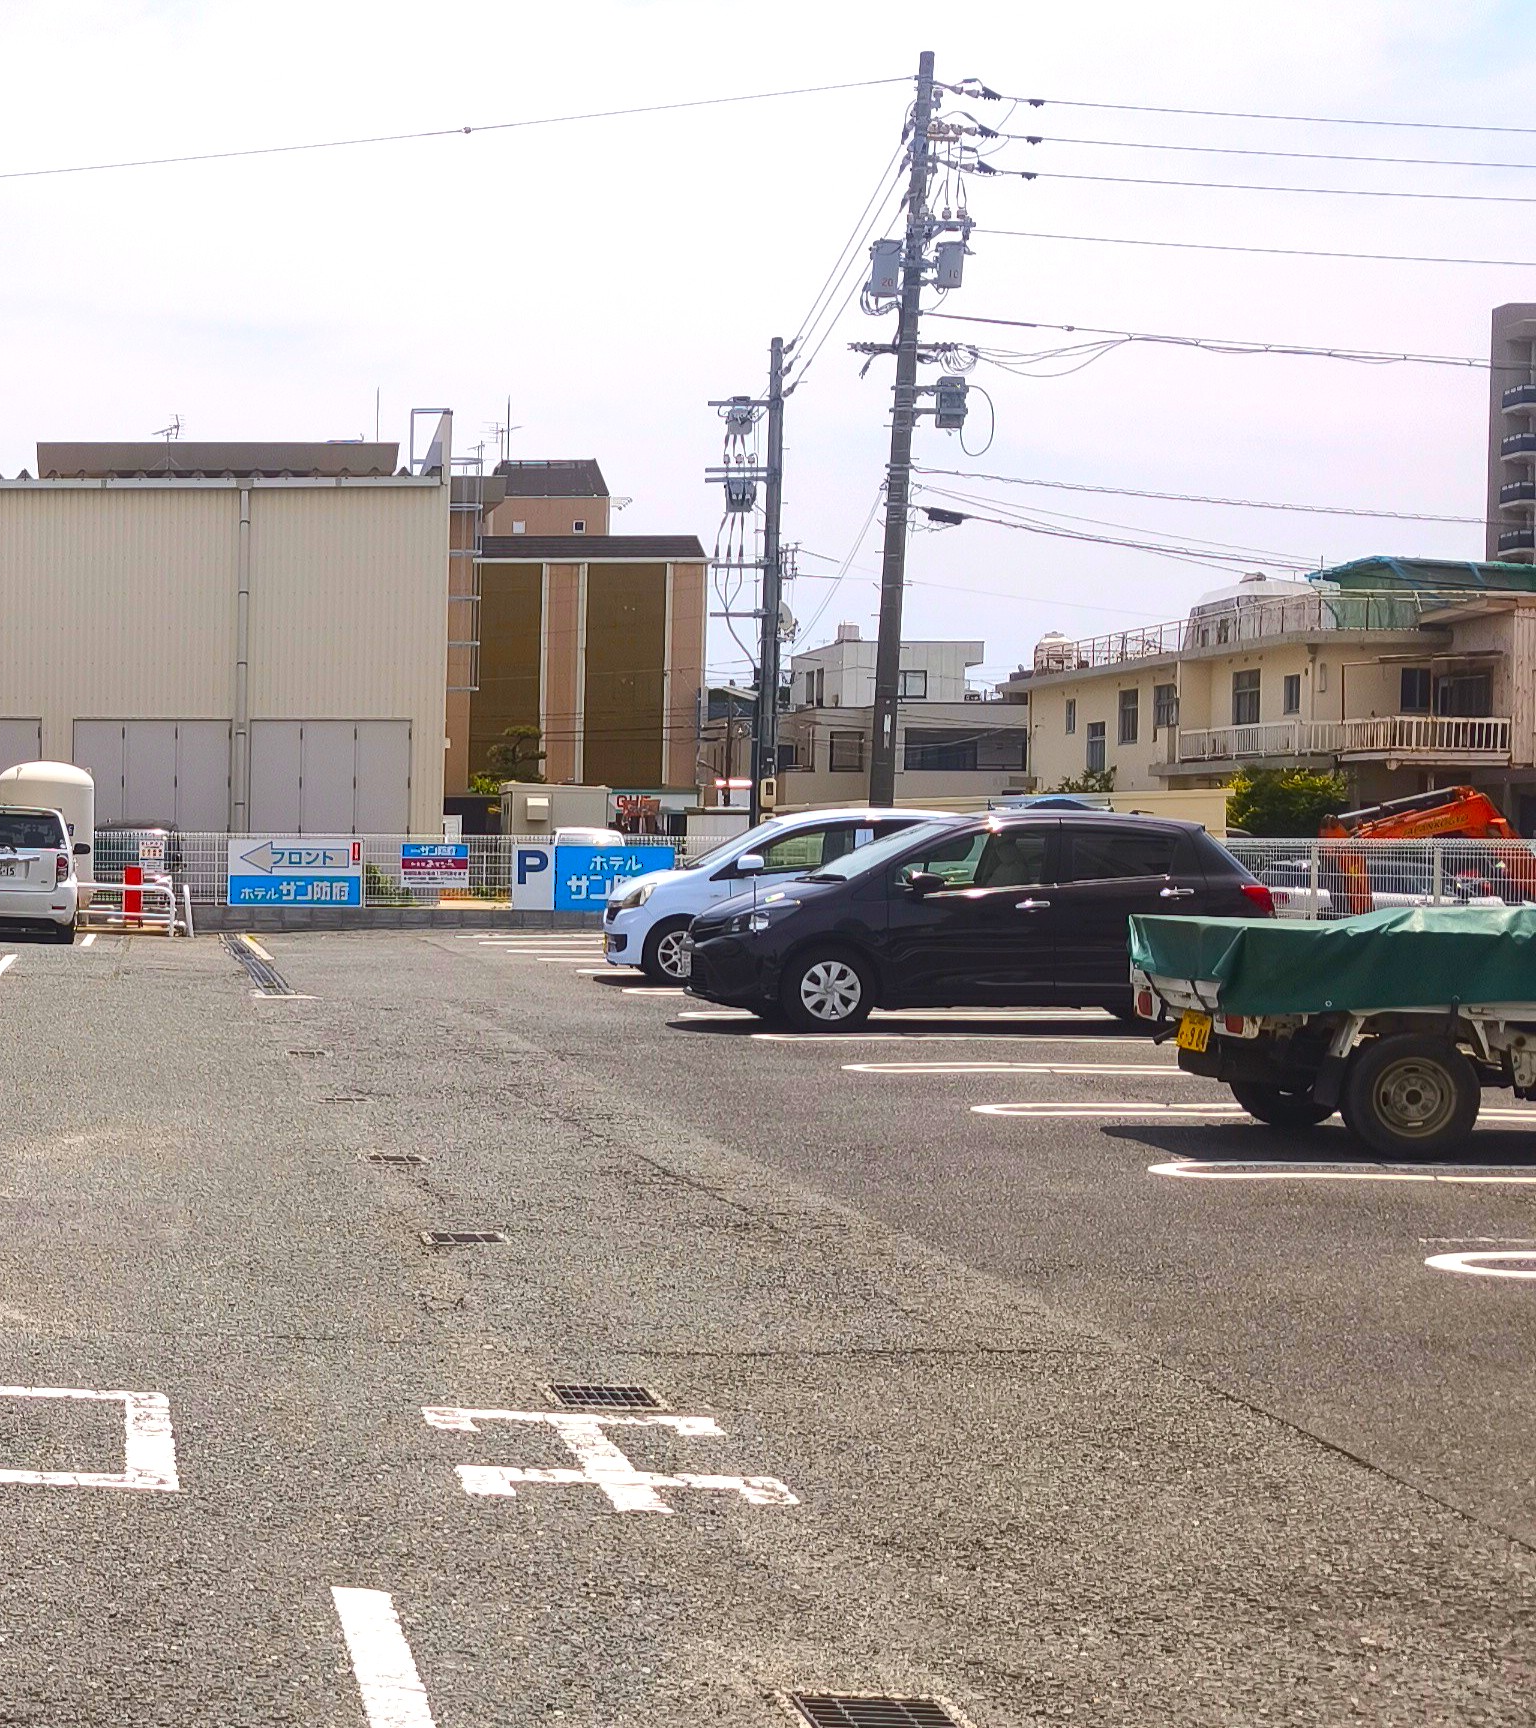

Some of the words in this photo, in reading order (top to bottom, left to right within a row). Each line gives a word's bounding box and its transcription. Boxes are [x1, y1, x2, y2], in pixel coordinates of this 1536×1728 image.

[271, 851, 334, 866] フロント
[517, 849, 549, 885] P
[589, 854, 643, 872] ホテル
[239, 880, 350, 901] ホテルサン防府
